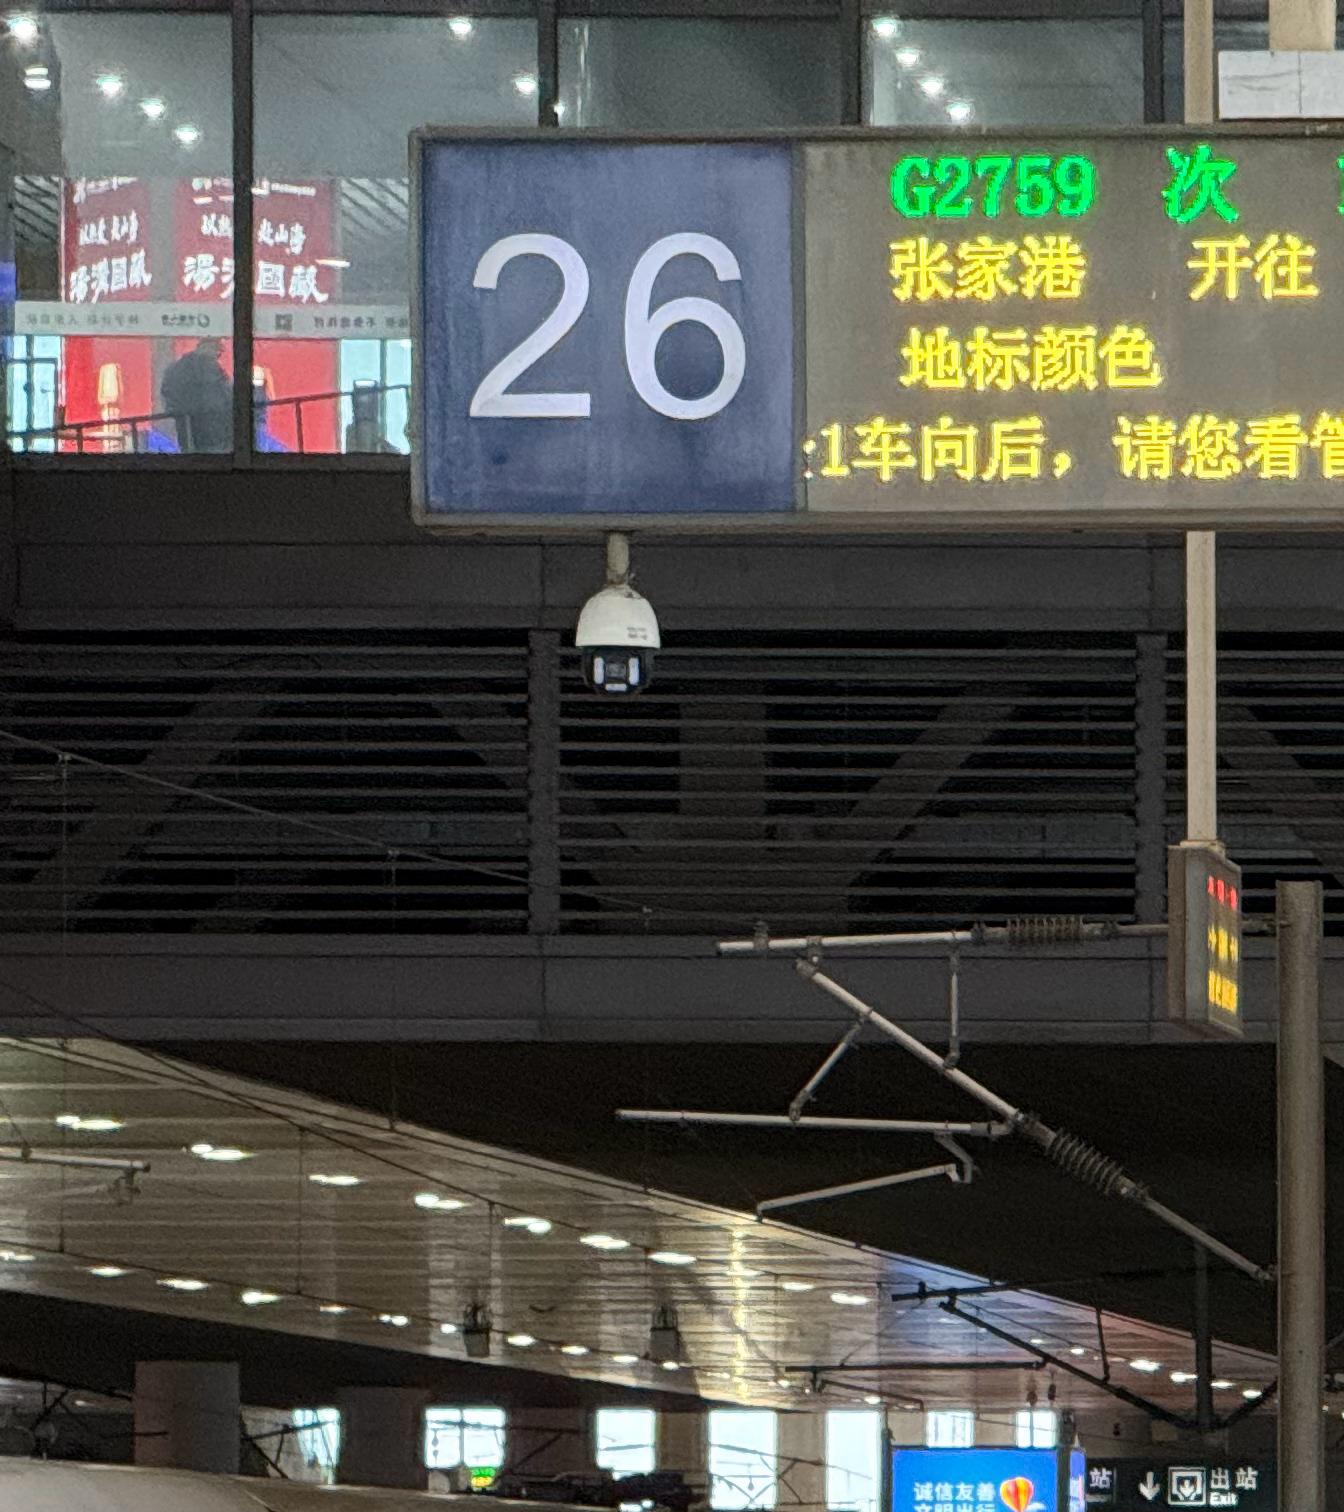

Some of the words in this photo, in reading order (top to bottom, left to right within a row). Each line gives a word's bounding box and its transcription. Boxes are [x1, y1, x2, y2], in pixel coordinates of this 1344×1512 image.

[890, 155, 1095, 218] G2759
[1162, 144, 1239, 225] 次
[890, 235, 1086, 303] 张家港
[1191, 234, 1317, 299] 开往
[469, 232, 748, 421] 26
[901, 324, 1160, 392] 地标颜色
[913, 1482, 995, 1501] 诚信友善
[1210, 1467, 1259, 1490] 出站
[1210, 1492, 1238, 1507] Exit
